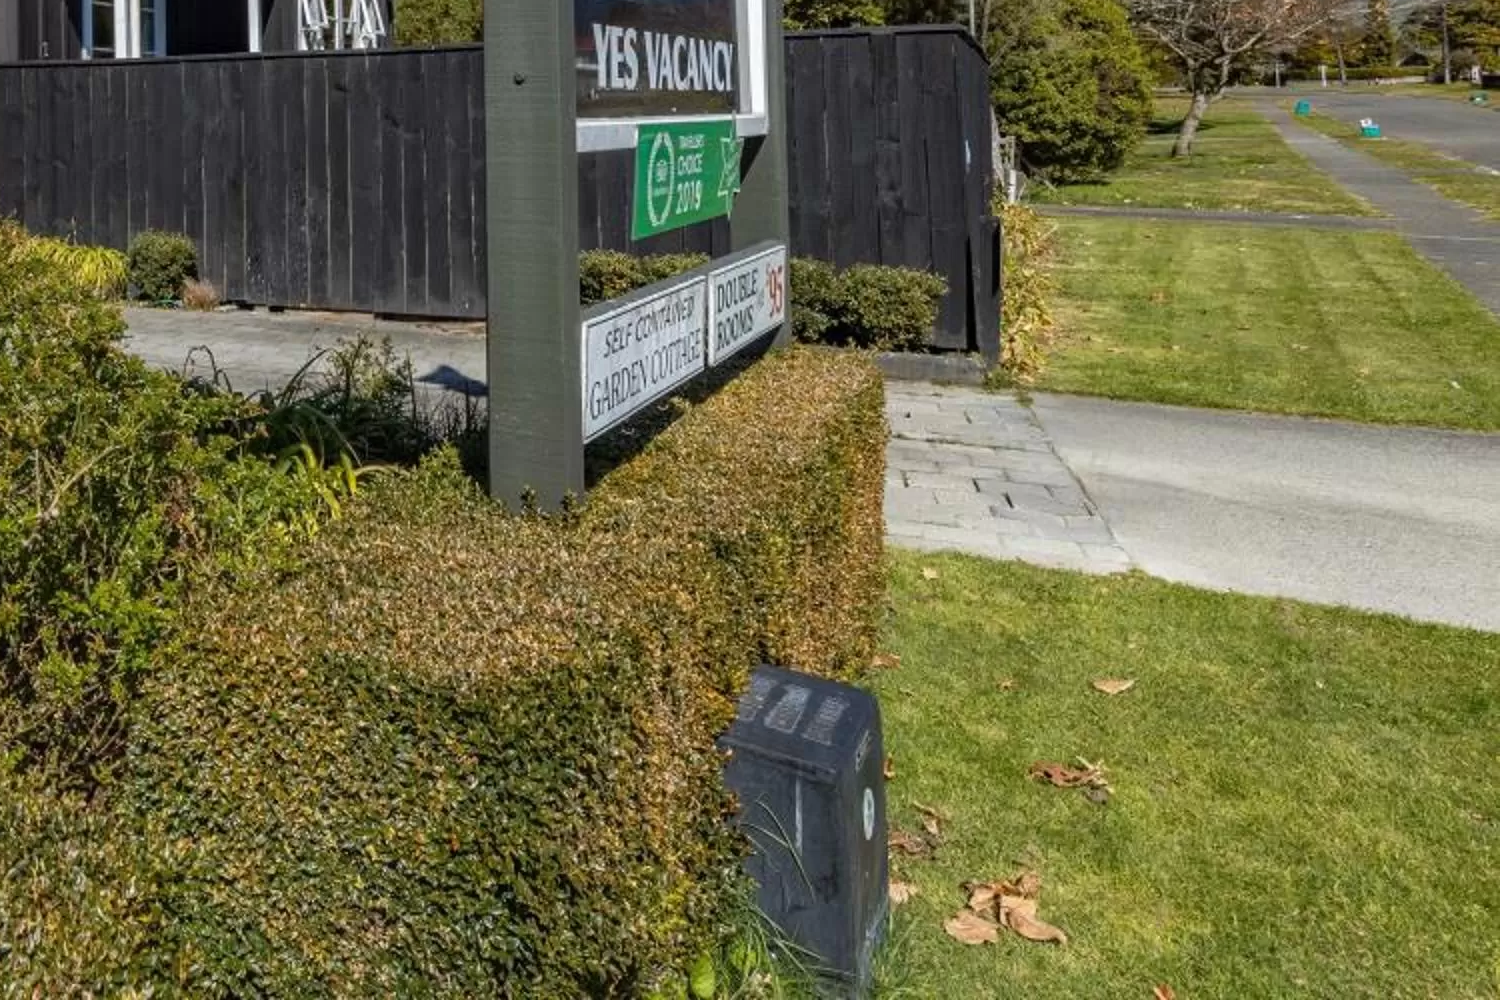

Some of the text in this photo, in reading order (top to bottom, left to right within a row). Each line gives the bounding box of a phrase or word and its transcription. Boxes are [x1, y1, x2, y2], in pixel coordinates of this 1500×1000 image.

[592, 22, 734, 92] YES VACANCY
[675, 180, 703, 215] 2019
[717, 266, 759, 313] DOUBLE
[603, 295, 695, 358] SELF CONTAINED
[717, 304, 755, 351] ROOMS
[589, 327, 701, 421] GARDEN COTTAGE
